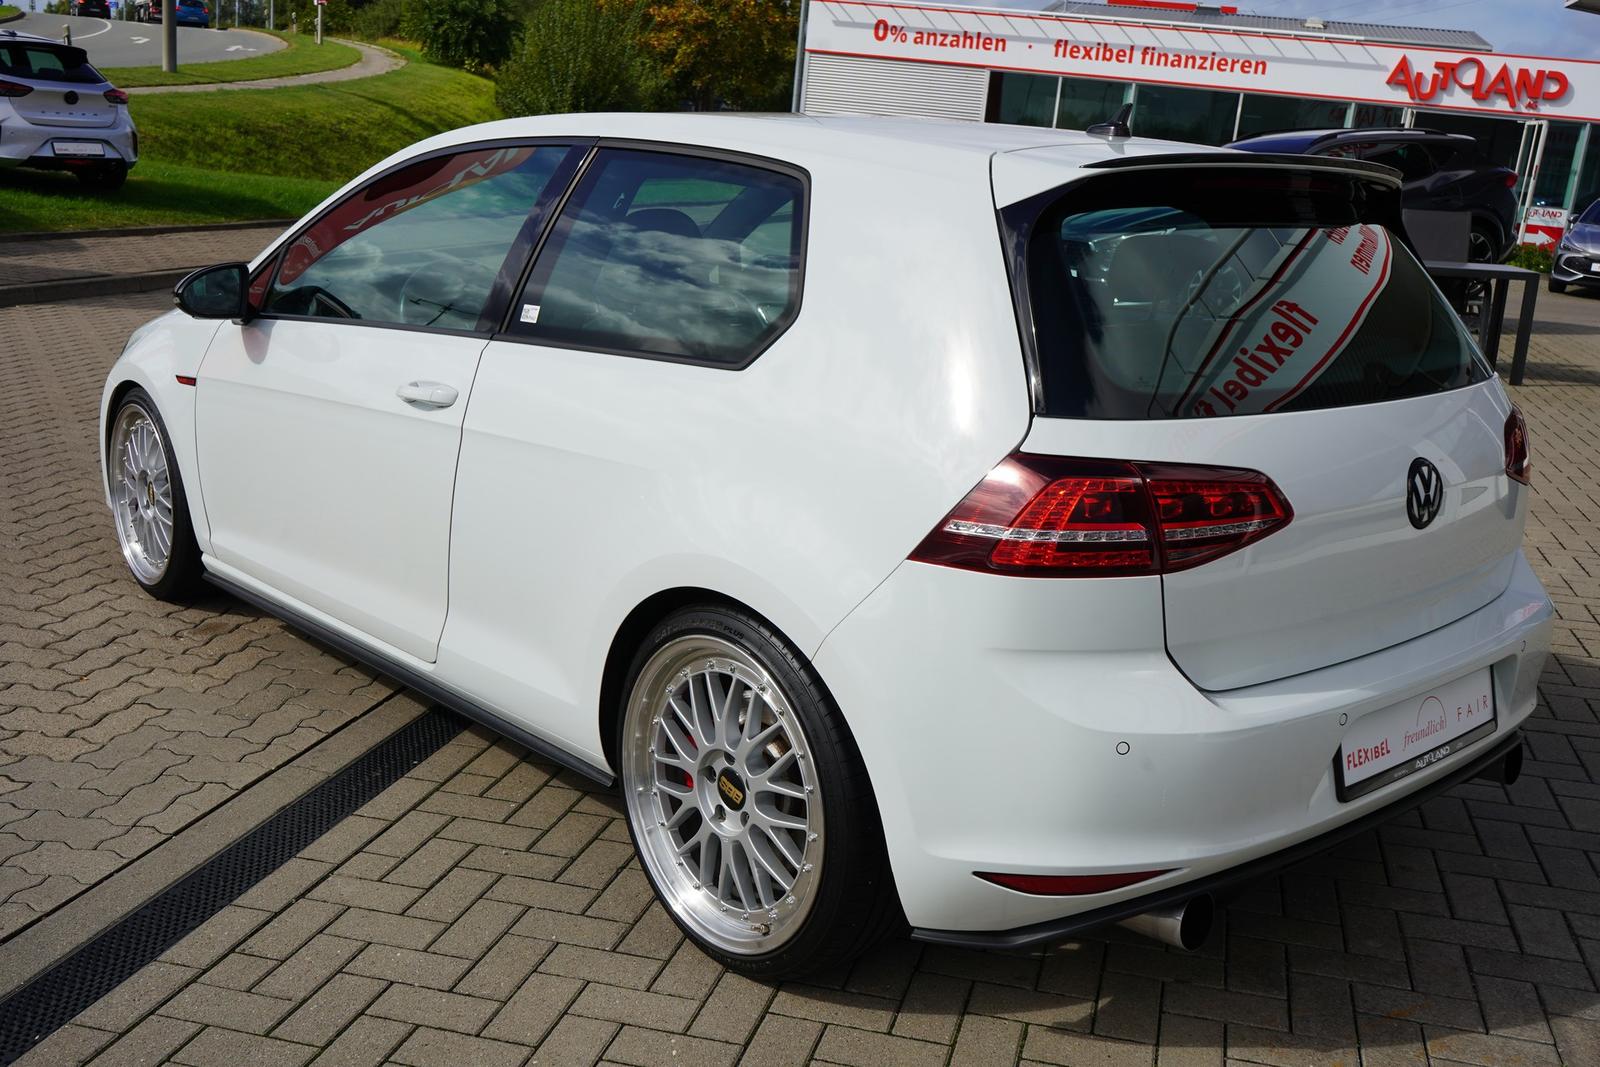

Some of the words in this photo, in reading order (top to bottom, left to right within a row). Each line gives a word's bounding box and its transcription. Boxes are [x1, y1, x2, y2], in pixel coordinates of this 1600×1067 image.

[873, 18, 907, 43] 0%
[913, 30, 1006, 52] anzahlen
[1053, 38, 1135, 64] flexibel
[1140, 46, 1268, 75] finanzieren
[1385, 54, 1569, 110] AUTOLAND
[1346, 738, 1391, 770] FLEXIBEL
[1402, 715, 1447, 752] freundlich
[1456, 695, 1488, 722] FAIR
[1415, 745, 1450, 769] AUTOLAND
[719, 775, 744, 805] BBS
